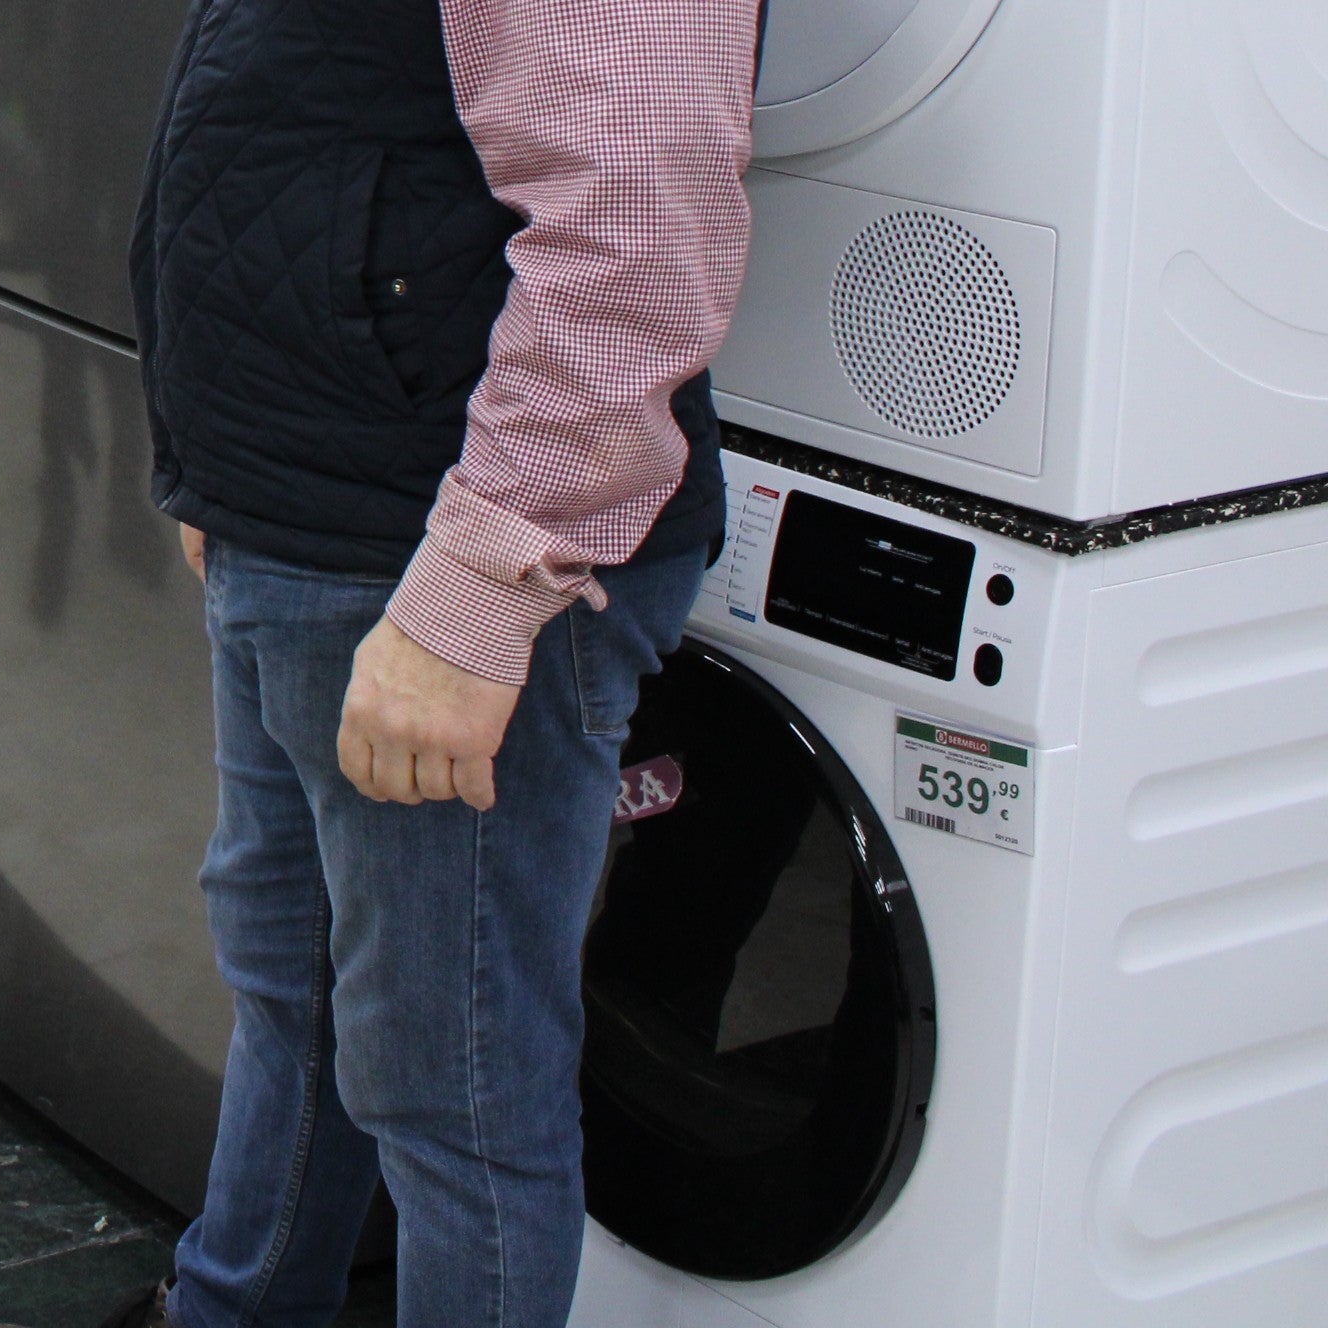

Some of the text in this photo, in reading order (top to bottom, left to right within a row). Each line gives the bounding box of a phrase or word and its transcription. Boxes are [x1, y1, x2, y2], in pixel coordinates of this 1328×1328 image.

[993, 562, 1015, 573] On/Off
[948, 735, 987, 752] BERMELLO
[918, 763, 989, 814] 539
[1000, 809, 1008, 820] €
